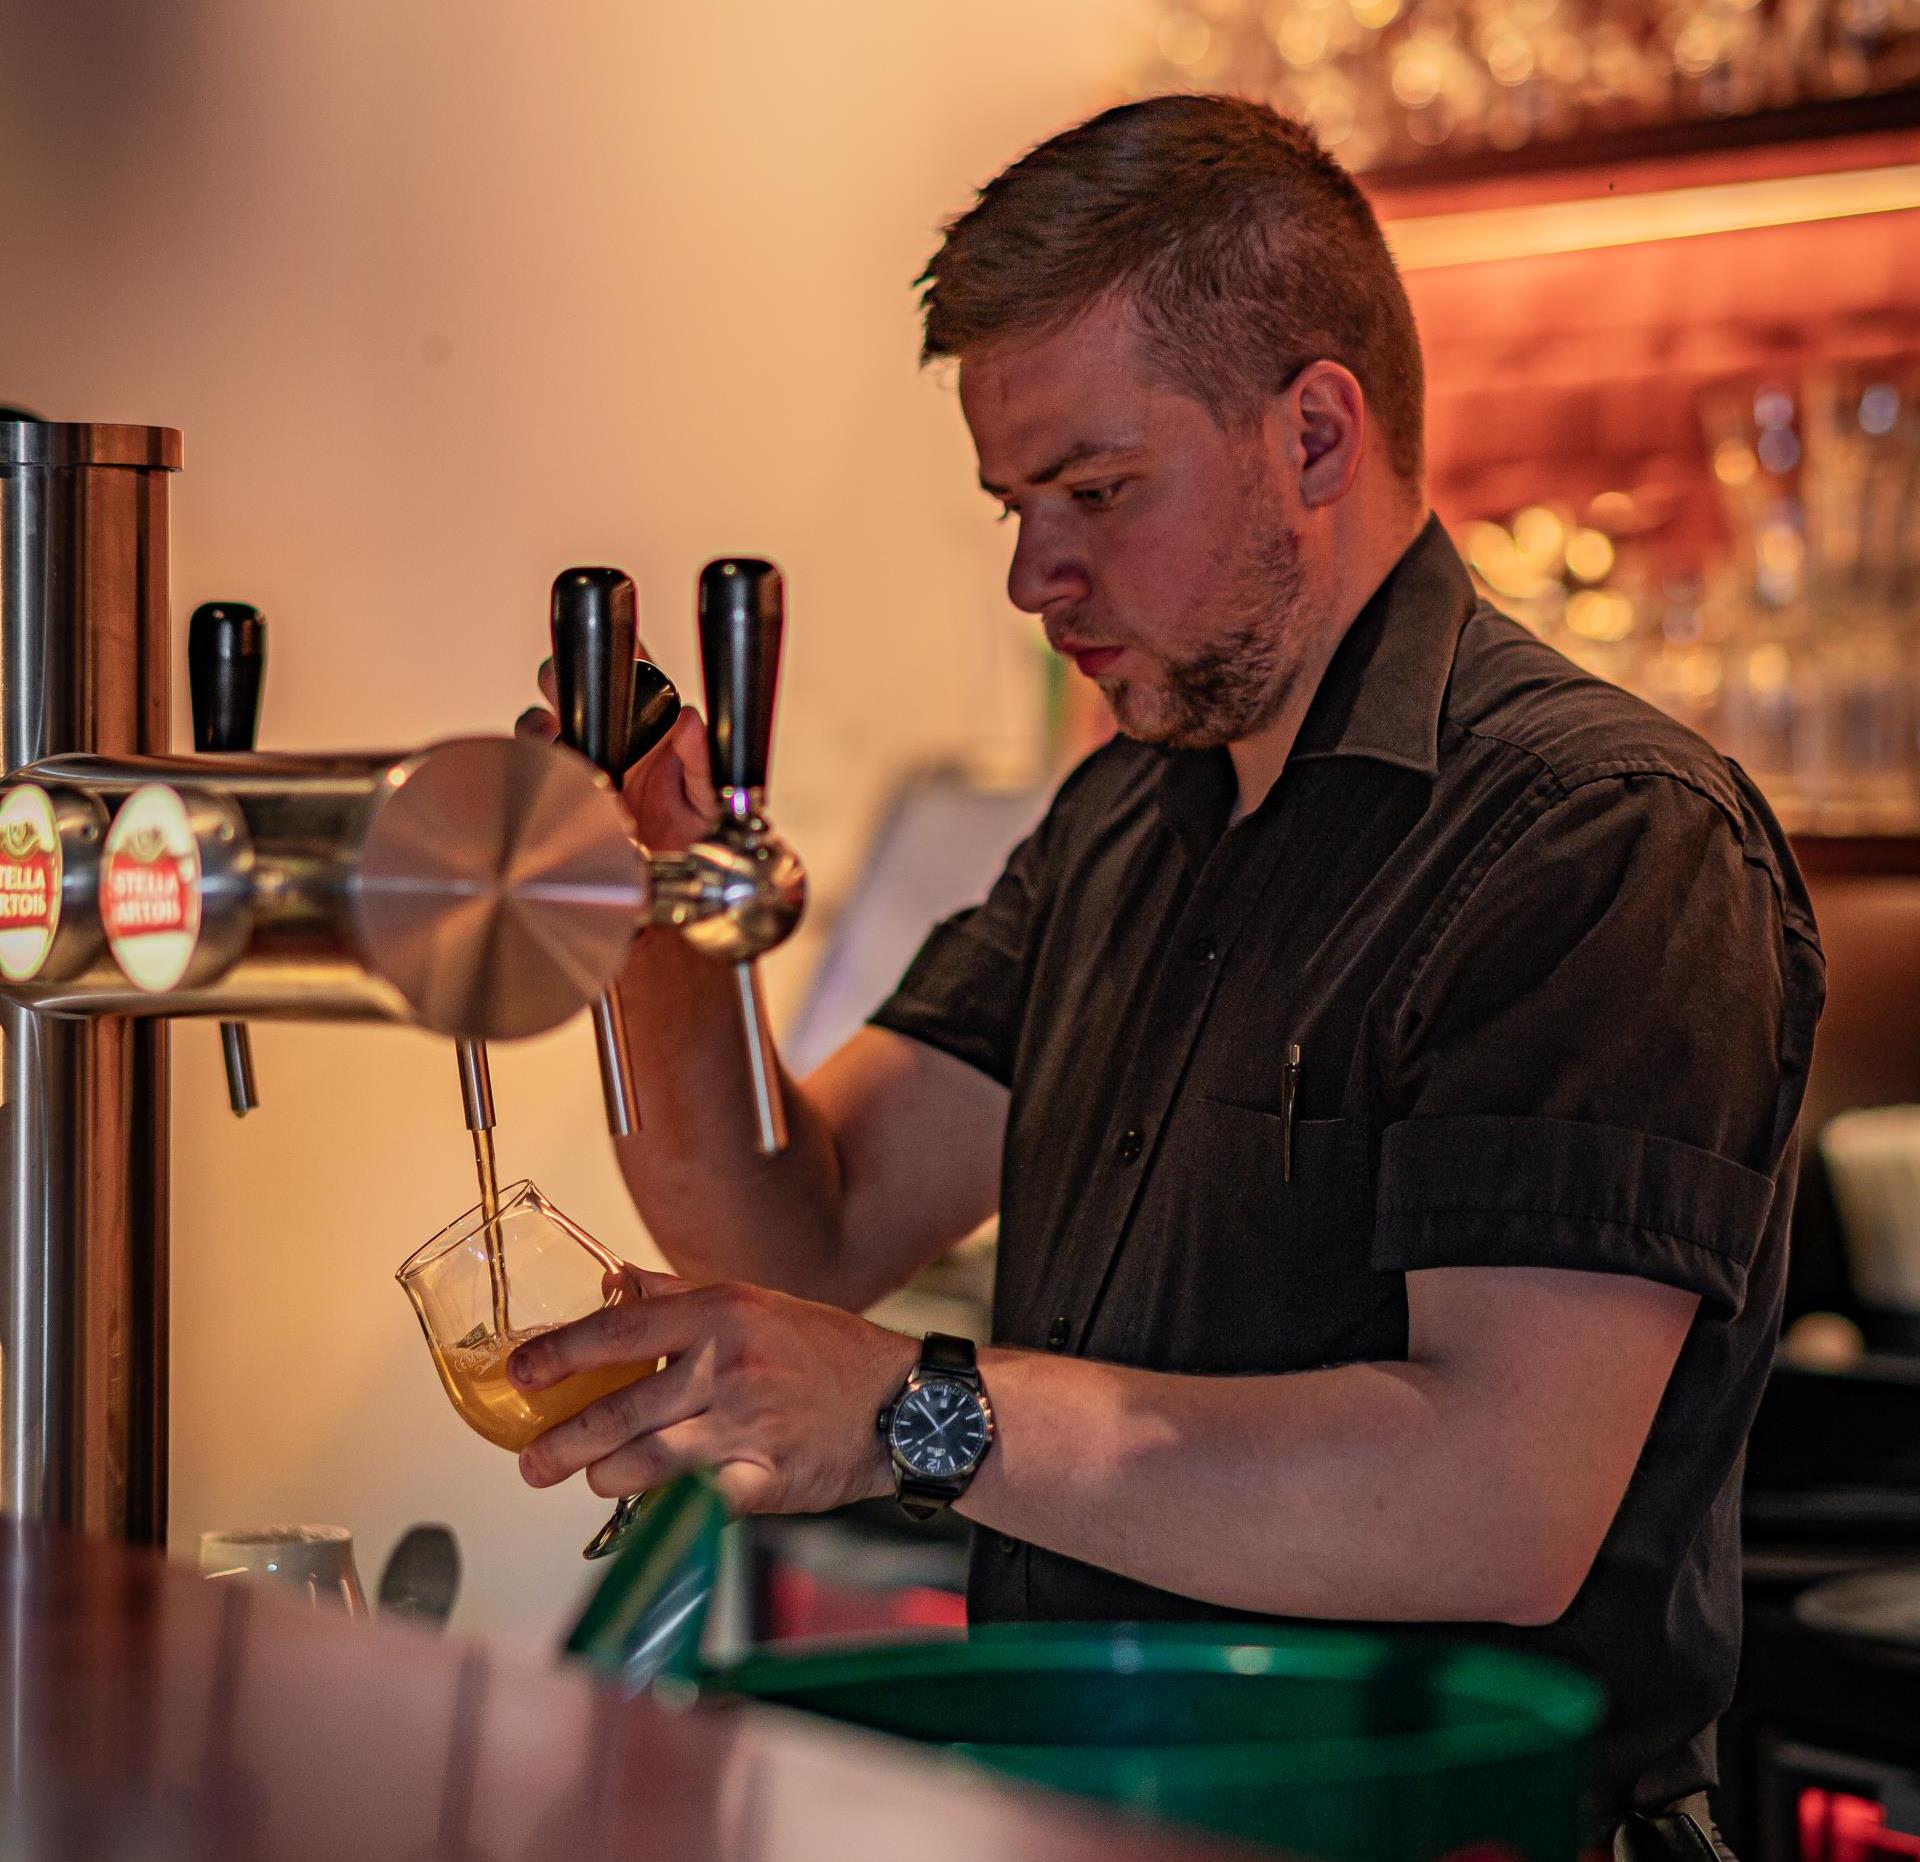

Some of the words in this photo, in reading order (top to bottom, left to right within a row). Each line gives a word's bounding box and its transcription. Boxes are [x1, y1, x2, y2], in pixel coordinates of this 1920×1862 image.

[0, 865, 46, 891] TELLA
[0, 893, 47, 917] RTOIS
[926, 1458, 941, 1471] 12
